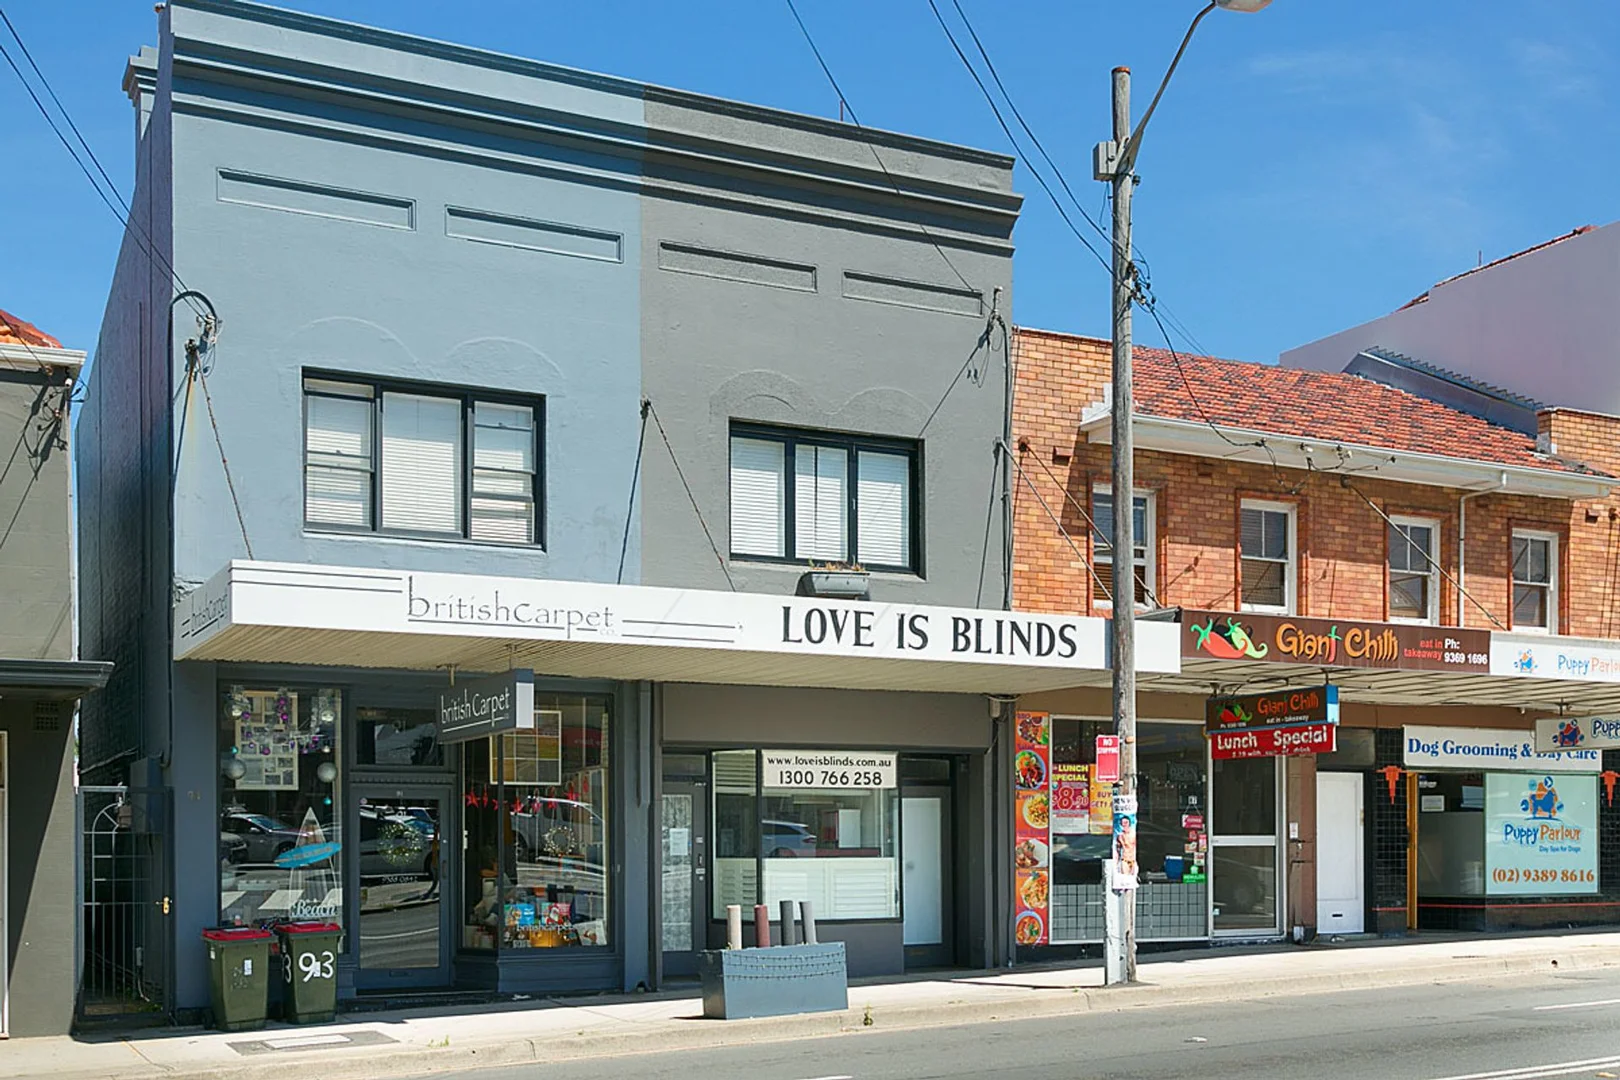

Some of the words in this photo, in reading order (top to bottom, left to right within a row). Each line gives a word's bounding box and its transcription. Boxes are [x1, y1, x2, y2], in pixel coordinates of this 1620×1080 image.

[781, 605, 875, 648] LOVE
[896, 612, 930, 650] IS
[952, 617, 1077, 659] BLINDS
[1275, 623, 1342, 663] Giant
[1344, 627, 1399, 662] Chilli
[1419, 639, 1433, 648] eat
[1434, 640, 1443, 649] in
[1444, 638, 1461, 650] Ph:
[1403, 648, 1443, 661] takeaway
[1558, 655, 1590, 675] Puppy
[1257, 695, 1288, 715] Giant
[1290, 691, 1319, 711] Chilli
[1217, 732, 1258, 750] Lunch
[1273, 725, 1328, 749] Special
[1408, 738, 1439, 757] Dog
[1442, 739, 1518, 760] Grooming
[1520, 743, 1532, 758] &
[767, 756, 891, 767] www.loveisblinds.com.au
[1058, 764, 1088, 772] LUNCH
[780, 770, 814, 785] 1300
[821, 771, 849, 785] 766
[853, 771, 882, 786] 258
[1052, 774, 1087, 782] SPECIAL
[1504, 823, 1539, 844] Puppy
[1540, 824, 1581, 840] Parlour
[1493, 867, 1520, 883] (02)
[1523, 869, 1558, 882] 9389
[1560, 869, 1595, 882] 8616
[299, 951, 334, 983] 93
